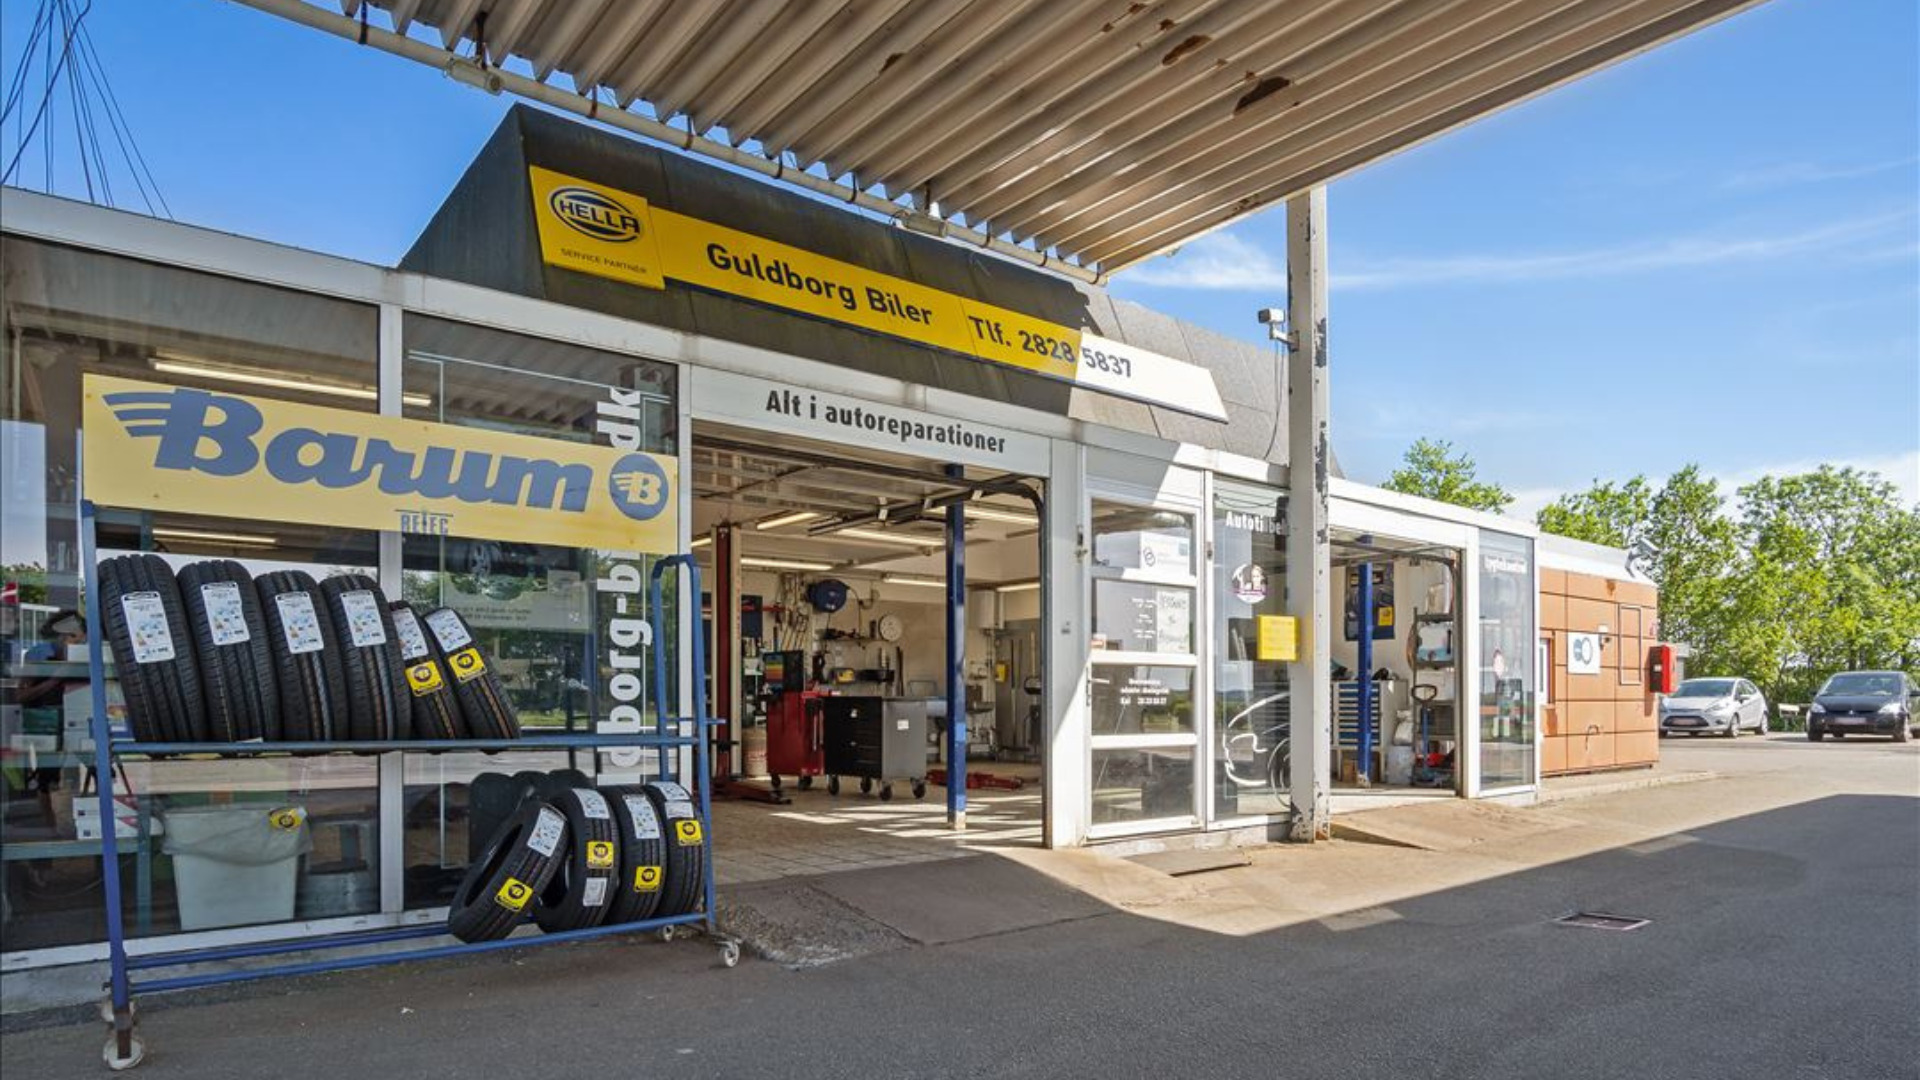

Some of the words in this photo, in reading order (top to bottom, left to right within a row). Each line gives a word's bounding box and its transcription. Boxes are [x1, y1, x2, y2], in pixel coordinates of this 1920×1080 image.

[559, 199, 640, 234] HELLA
[560, 248, 600, 264] SERVICE
[604, 258, 647, 274] PARTNER
[706, 243, 857, 311] Guldborg
[866, 287, 933, 325] Biler
[968, 316, 1012, 347] Tlf.
[1018, 330, 1076, 363] 2828
[1082, 347, 1132, 378] 5837
[103, 387, 593, 512] Barum
[765, 390, 801, 417] Alt
[810, 395, 817, 419] i
[825, 405, 1006, 454] autoreparationer
